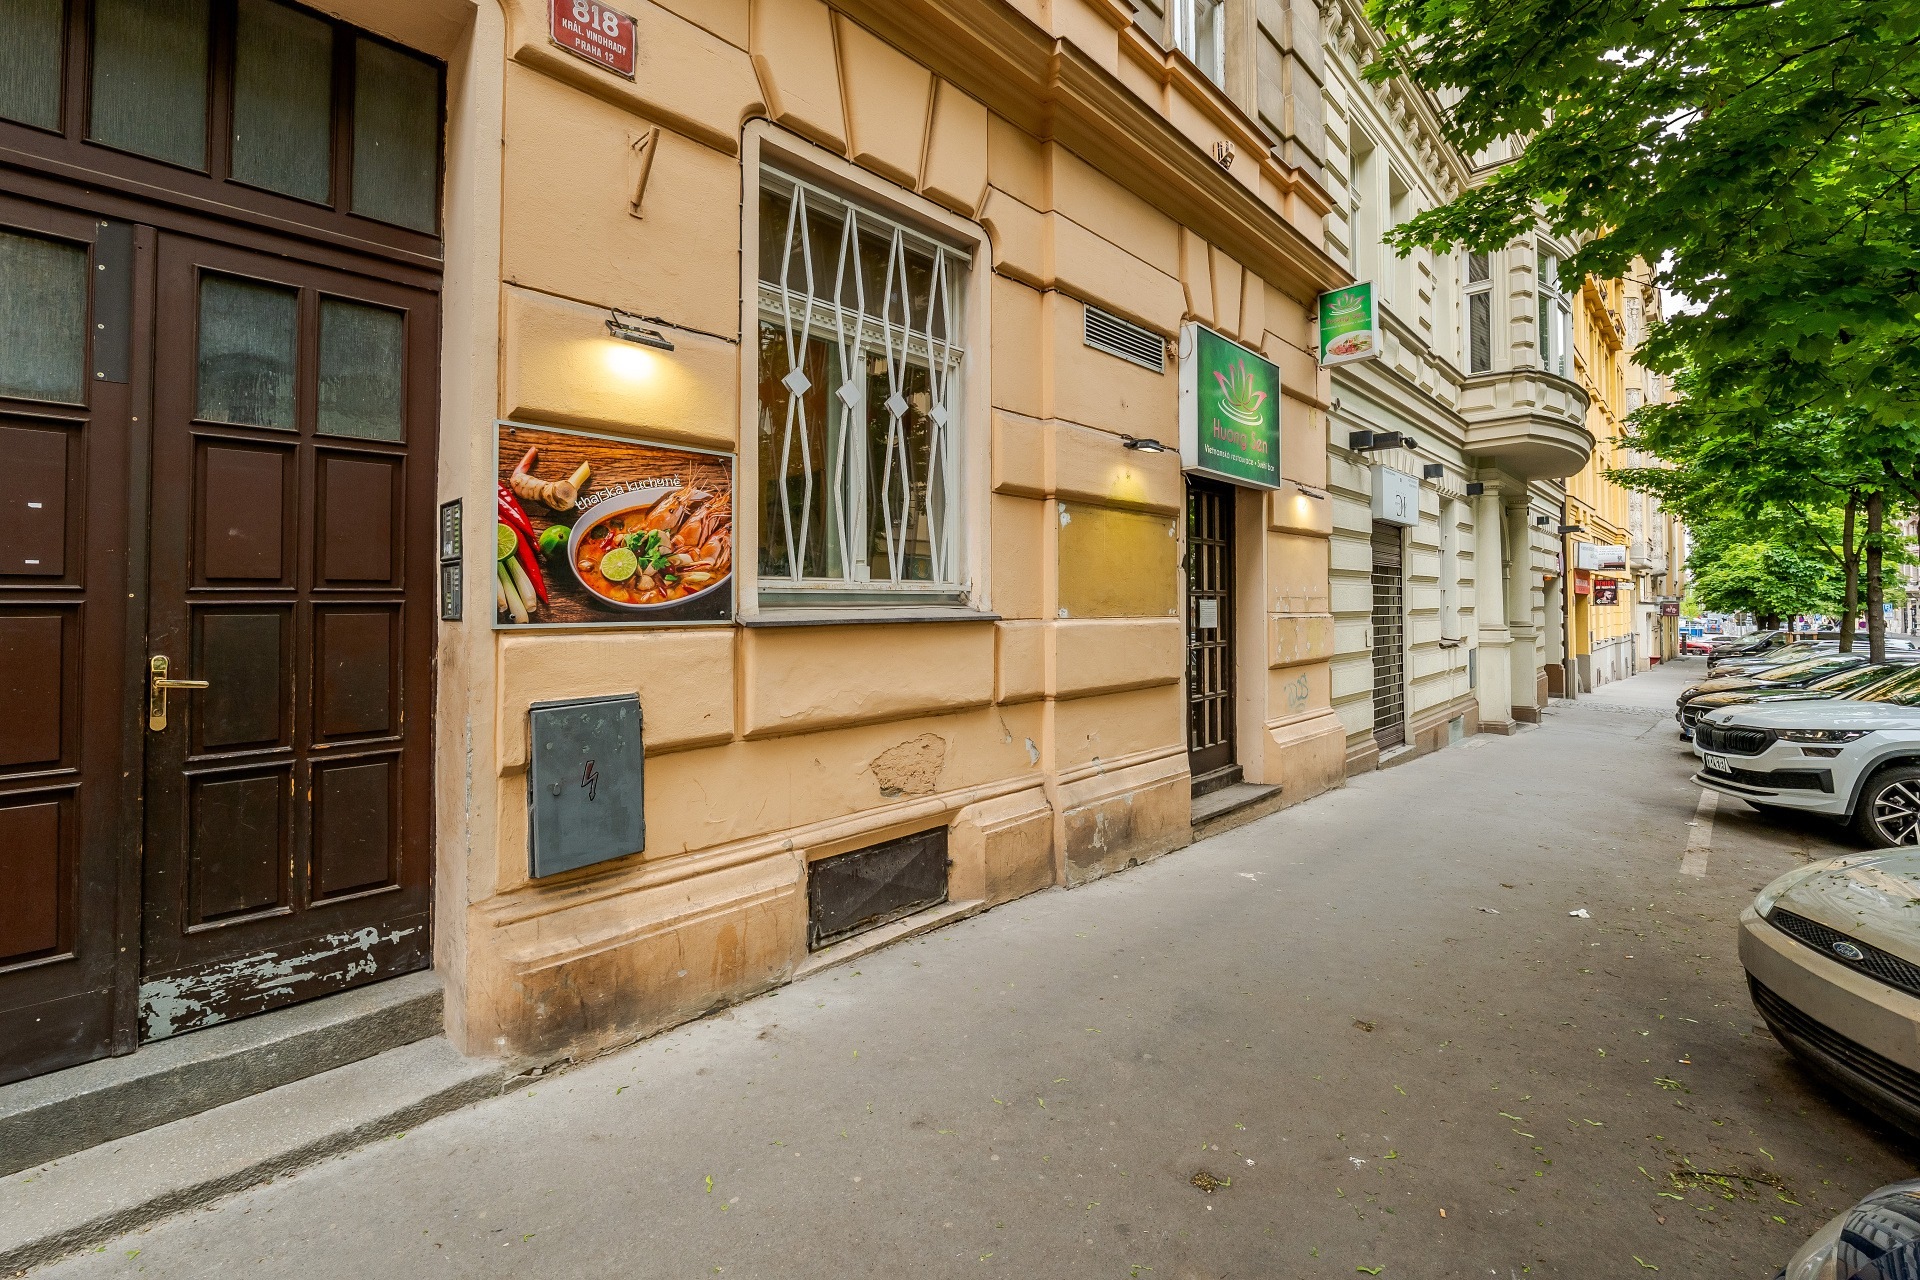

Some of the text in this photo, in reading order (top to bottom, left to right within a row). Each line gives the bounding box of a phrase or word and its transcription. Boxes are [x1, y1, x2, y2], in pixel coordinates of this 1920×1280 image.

[572, 0, 619, 37] 818
[562, 18, 626, 56] KRÁL. VINOHRADY
[575, 37, 614, 63] PRAHA 12
[1213, 418, 1268, 454] Huong Sen
[625, 474, 682, 493] kuchyně
